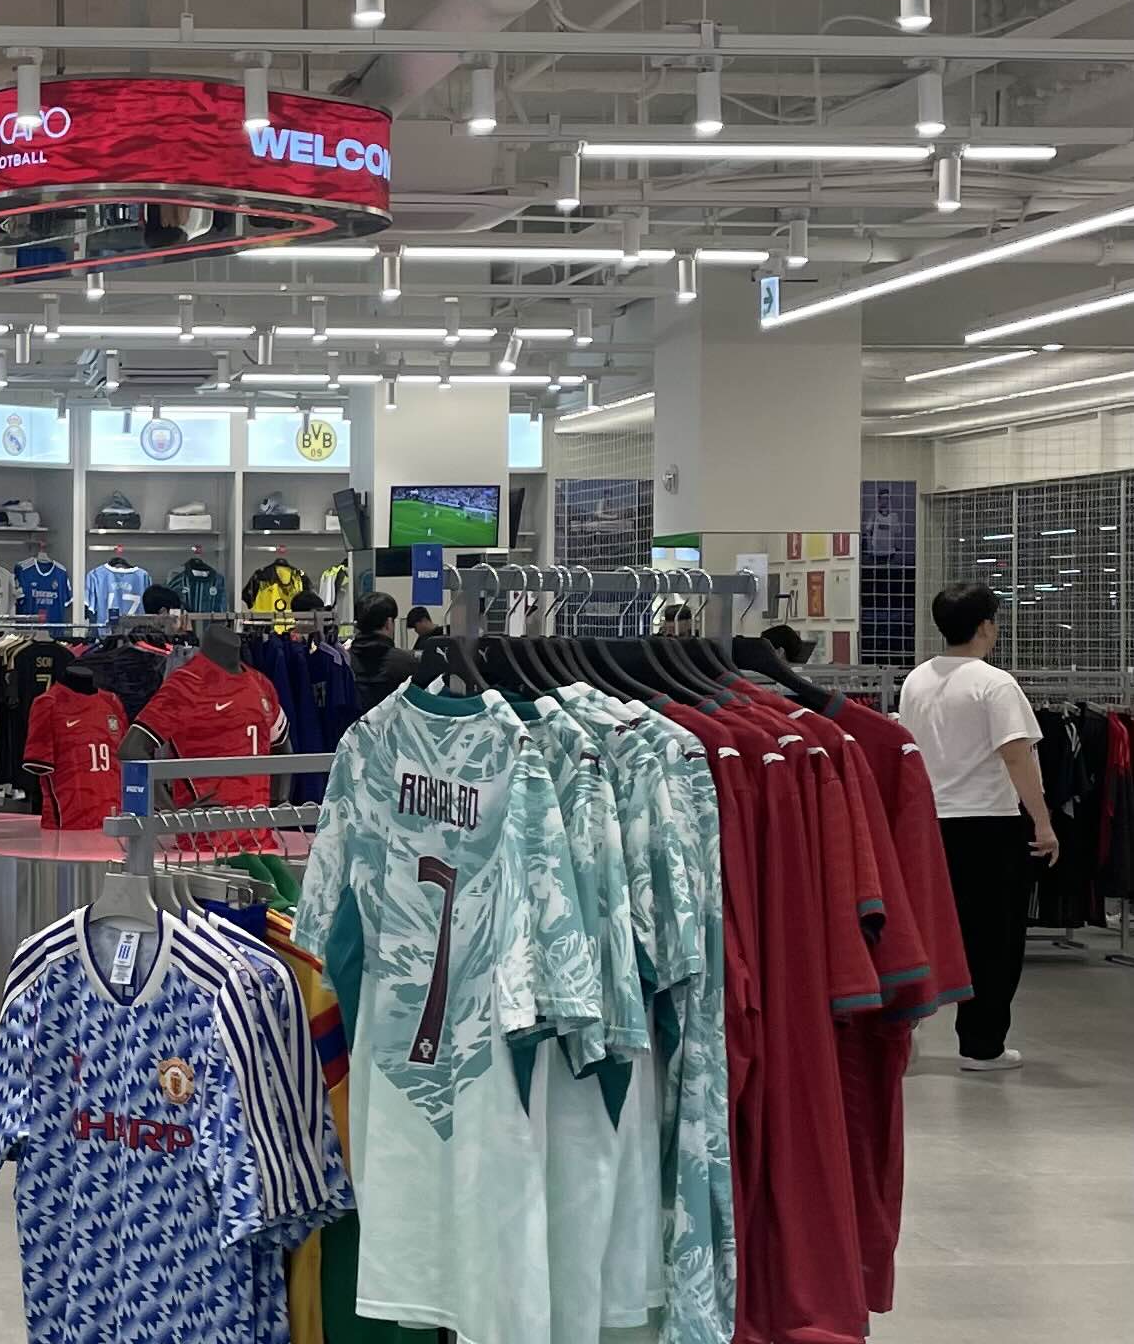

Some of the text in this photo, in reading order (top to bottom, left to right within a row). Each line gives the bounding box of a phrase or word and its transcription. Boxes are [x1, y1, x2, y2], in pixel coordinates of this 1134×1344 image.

[302, 423, 332, 448] BVB
[36, 656, 54, 668] SON
[247, 725, 258, 755] 7
[88, 743, 110, 772] 19
[398, 772, 479, 831] RONALDO
[408, 855, 457, 1065] 7
